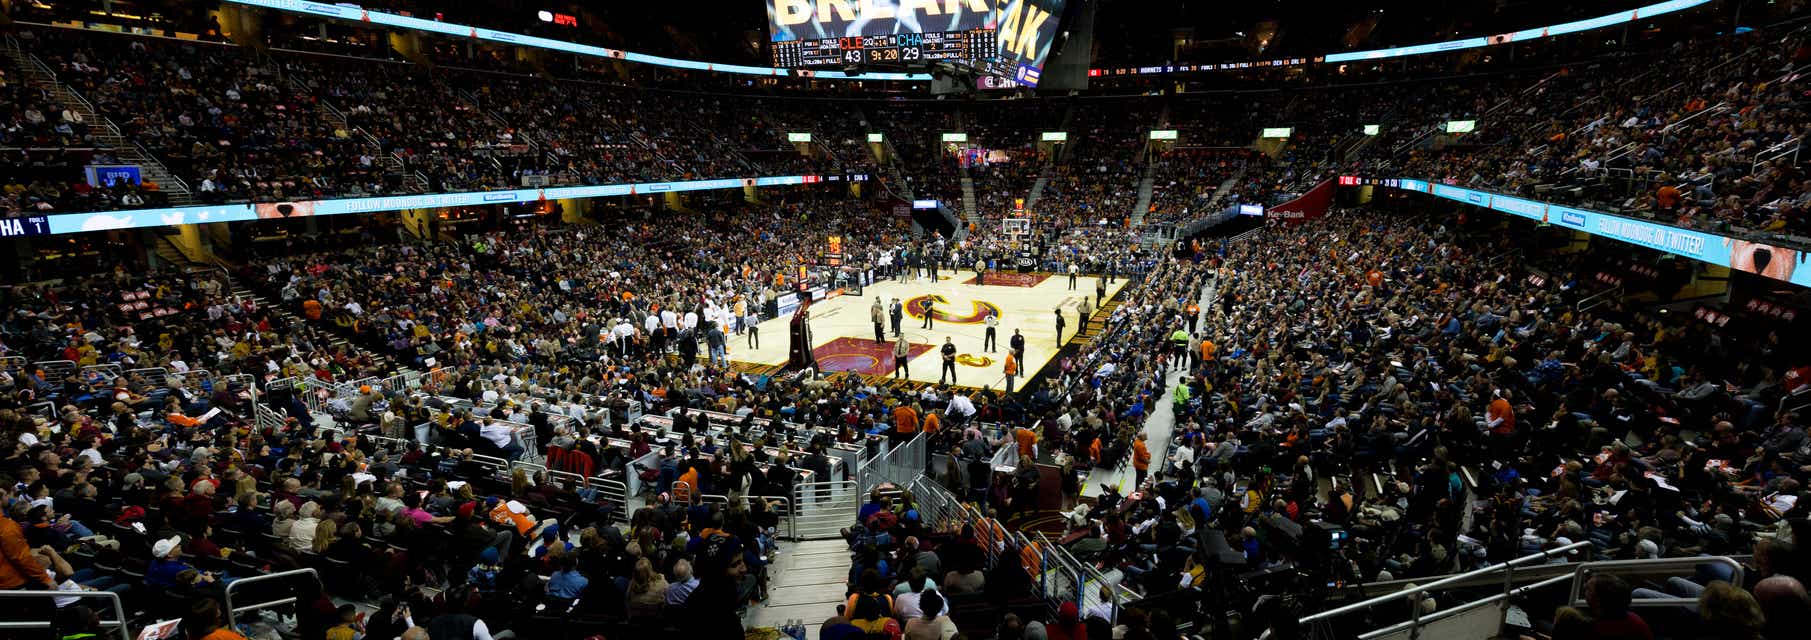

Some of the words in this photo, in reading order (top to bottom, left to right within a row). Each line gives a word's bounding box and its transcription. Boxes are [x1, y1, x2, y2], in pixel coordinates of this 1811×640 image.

[775, 0, 994, 26] BRE
[997, 0, 1049, 60] AK
[839, 37, 863, 50] CLE
[897, 33, 922, 47] CHA
[845, 50, 861, 63] 43
[902, 48, 920, 60] 29
[1140, 66, 1162, 74] HORNETS
[107, 171, 130, 180] BUD
[35, 222, 42, 234] 1
[1020, 258, 1032, 267] KIA
